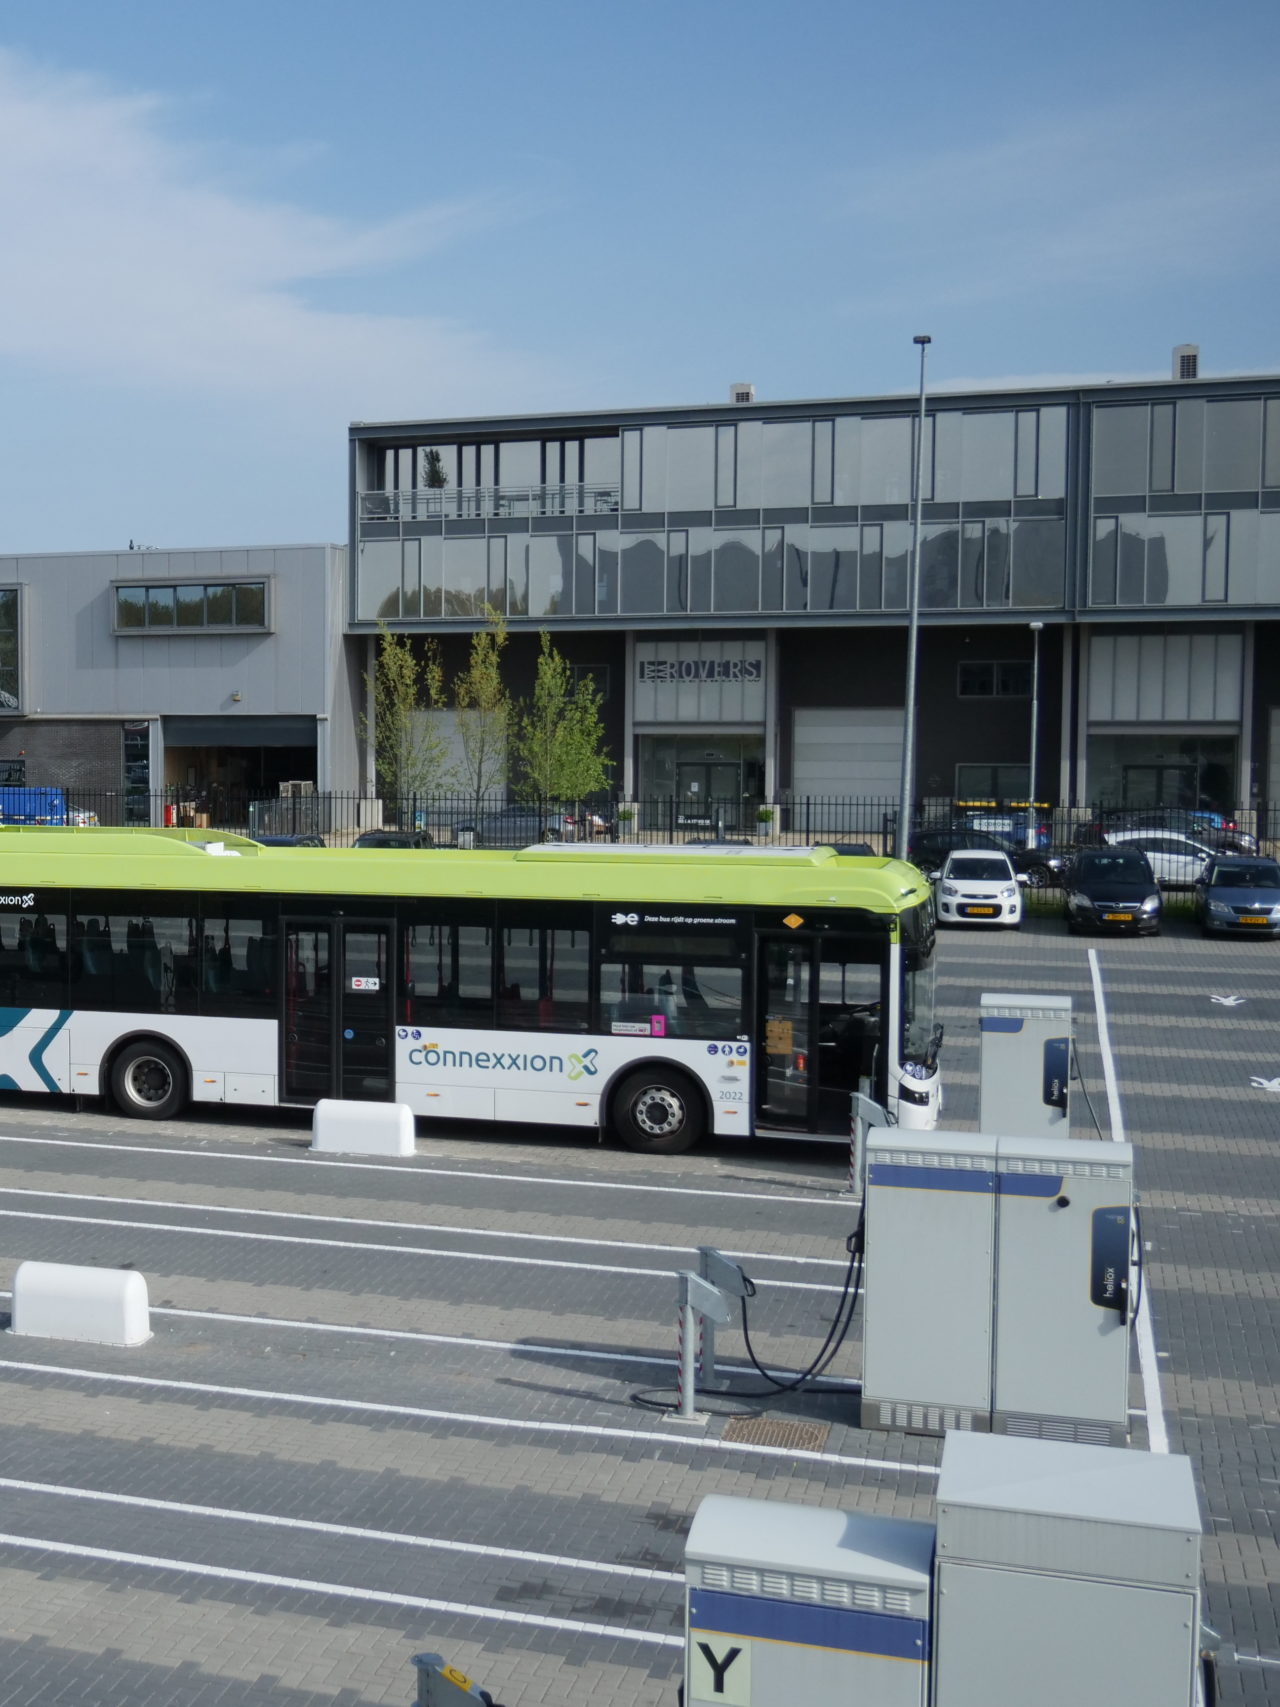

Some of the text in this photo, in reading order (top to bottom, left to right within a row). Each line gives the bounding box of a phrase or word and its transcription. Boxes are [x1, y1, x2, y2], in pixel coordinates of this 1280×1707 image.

[666, 659, 760, 680] ROVERS
[408, 1048, 563, 1073] connexxion
[719, 1090, 743, 1101] 2022
[1103, 1267, 1115, 1297] heliox
[696, 1641, 742, 1694] Y
